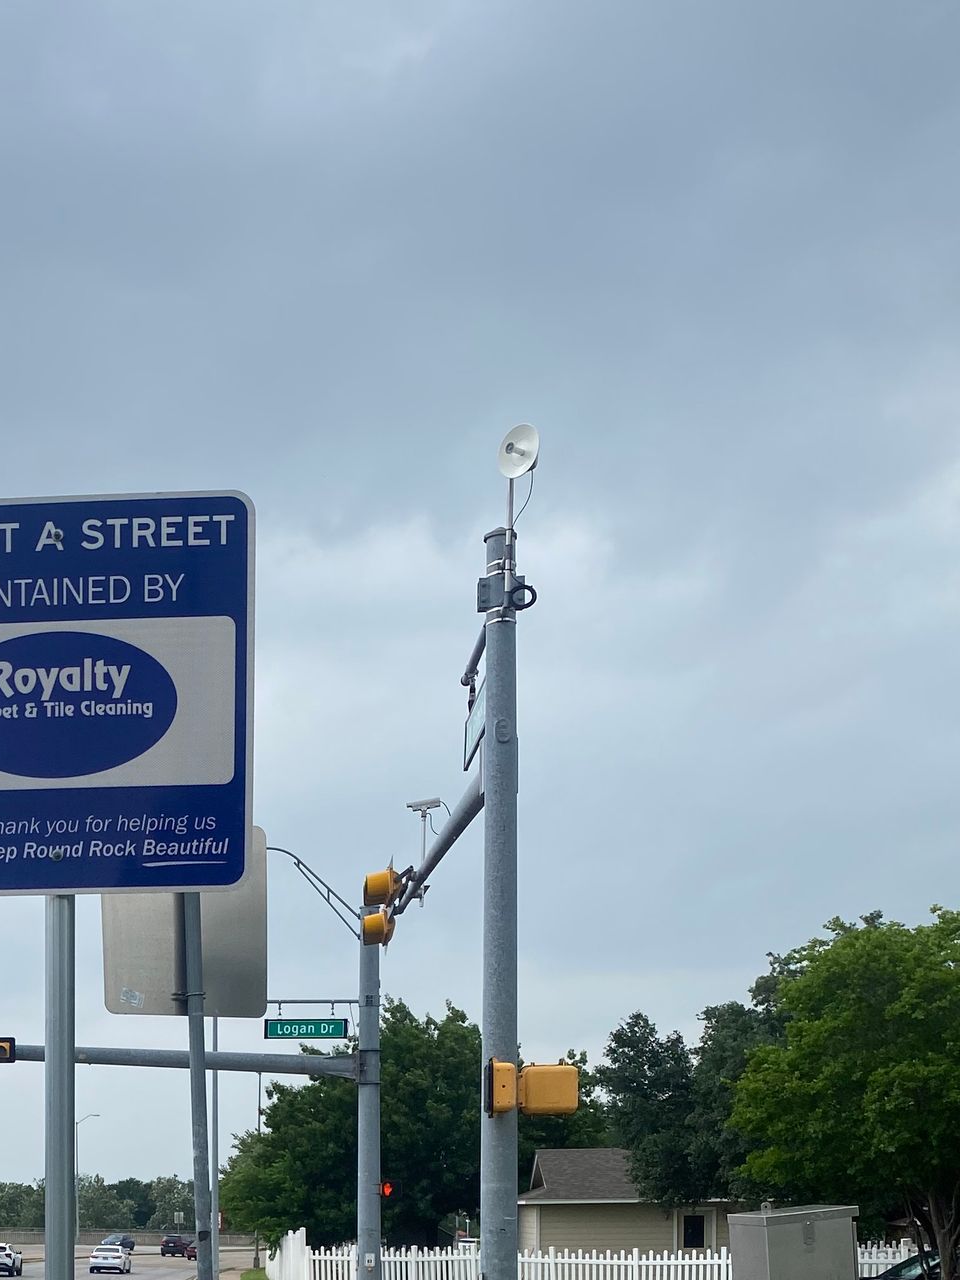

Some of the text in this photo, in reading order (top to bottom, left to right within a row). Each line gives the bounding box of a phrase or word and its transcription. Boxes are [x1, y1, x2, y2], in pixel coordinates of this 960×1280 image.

[35, 521, 64, 552] A
[80, 514, 235, 550] STREET
[144, 573, 185, 603] BY
[24, 702, 38, 718] &
[44, 701, 74, 717] Tile
[80, 700, 153, 718] Cleaning
[44, 819, 79, 838] you
[85, 815, 112, 833] for
[116, 814, 189, 835] helping
[194, 816, 216, 830] us
[23, 841, 83, 859] Round
[89, 840, 136, 857] Rock
[142, 838, 229, 856] Beautiful
[277, 1023, 334, 1036] Logan Dr
